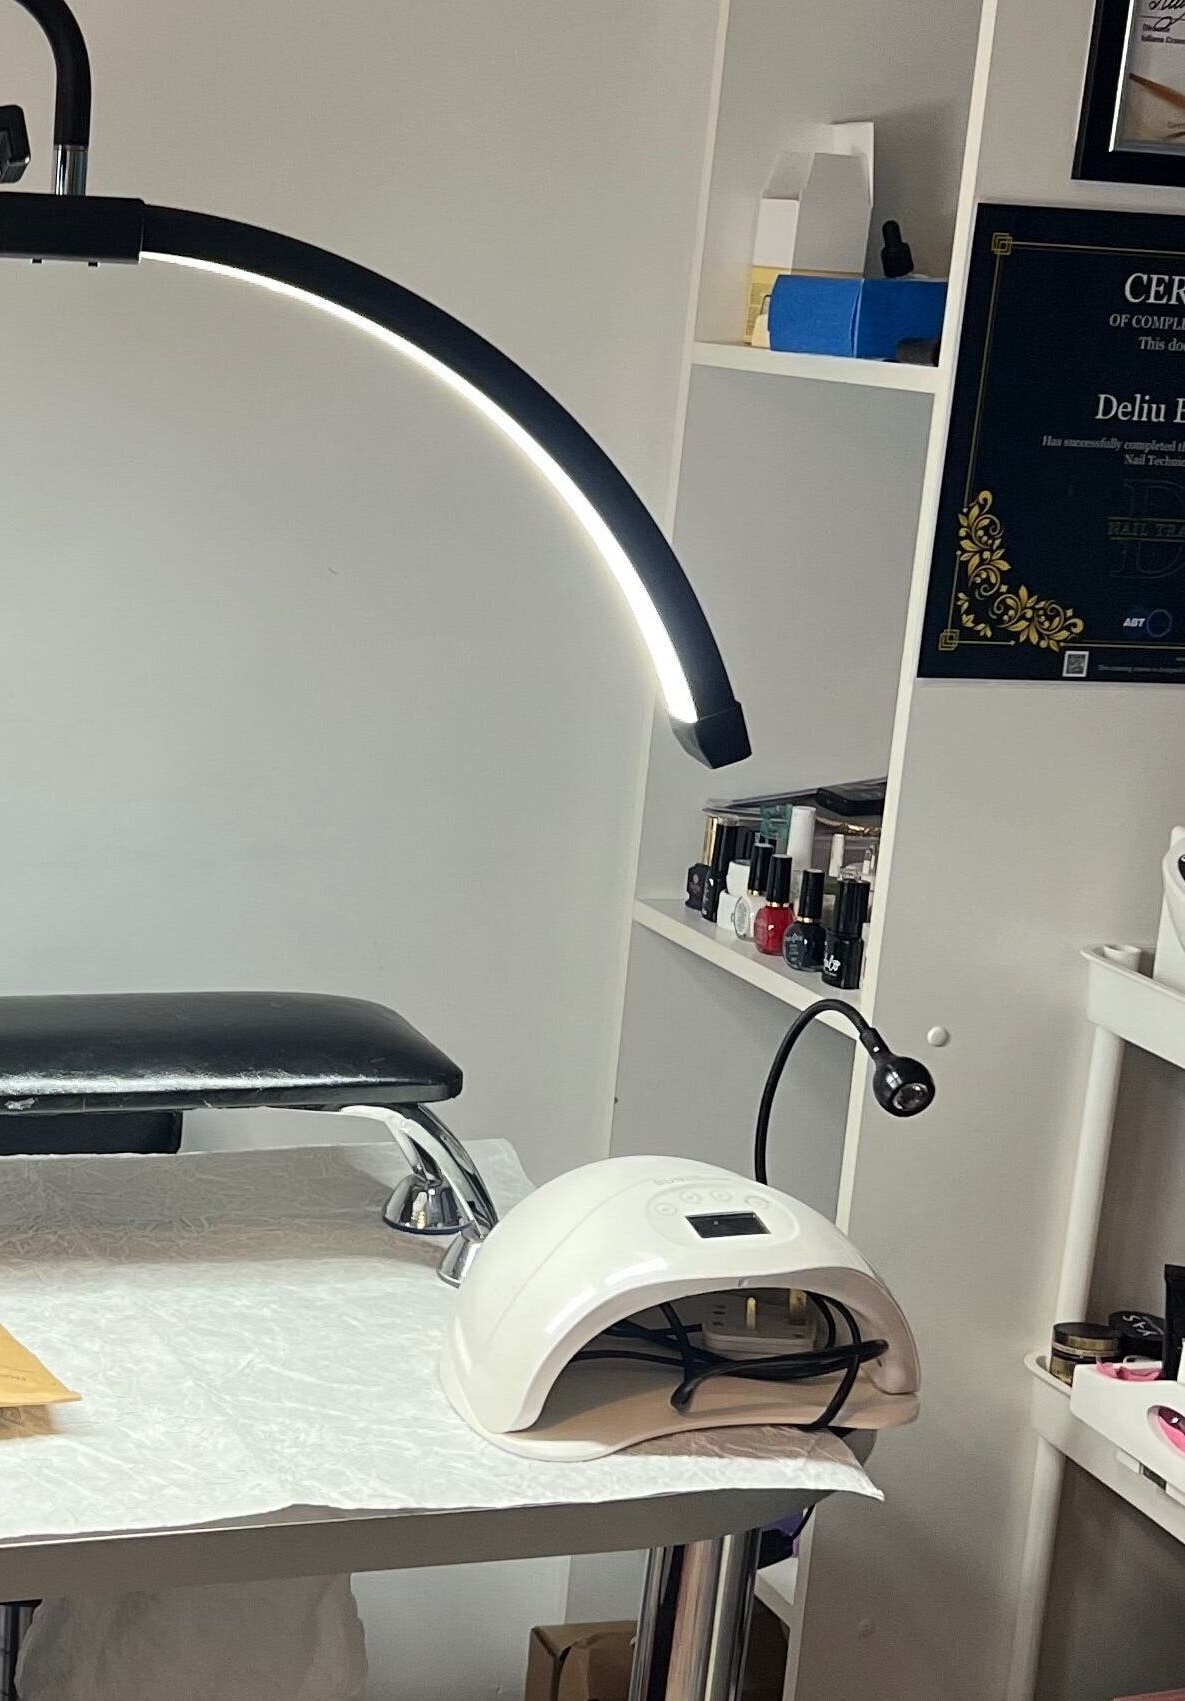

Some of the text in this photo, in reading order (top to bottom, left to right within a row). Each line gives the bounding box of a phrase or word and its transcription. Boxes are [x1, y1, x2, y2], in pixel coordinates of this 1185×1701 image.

[1109, 313, 1130, 328] OF
[1137, 336, 1165, 351] This
[1095, 393, 1166, 422] Deliu
[1041, 435, 1062, 447] Has
[1063, 438, 1123, 451] successfully
[1123, 440, 1176, 453] completed
[1124, 454, 1146, 465] Nail
